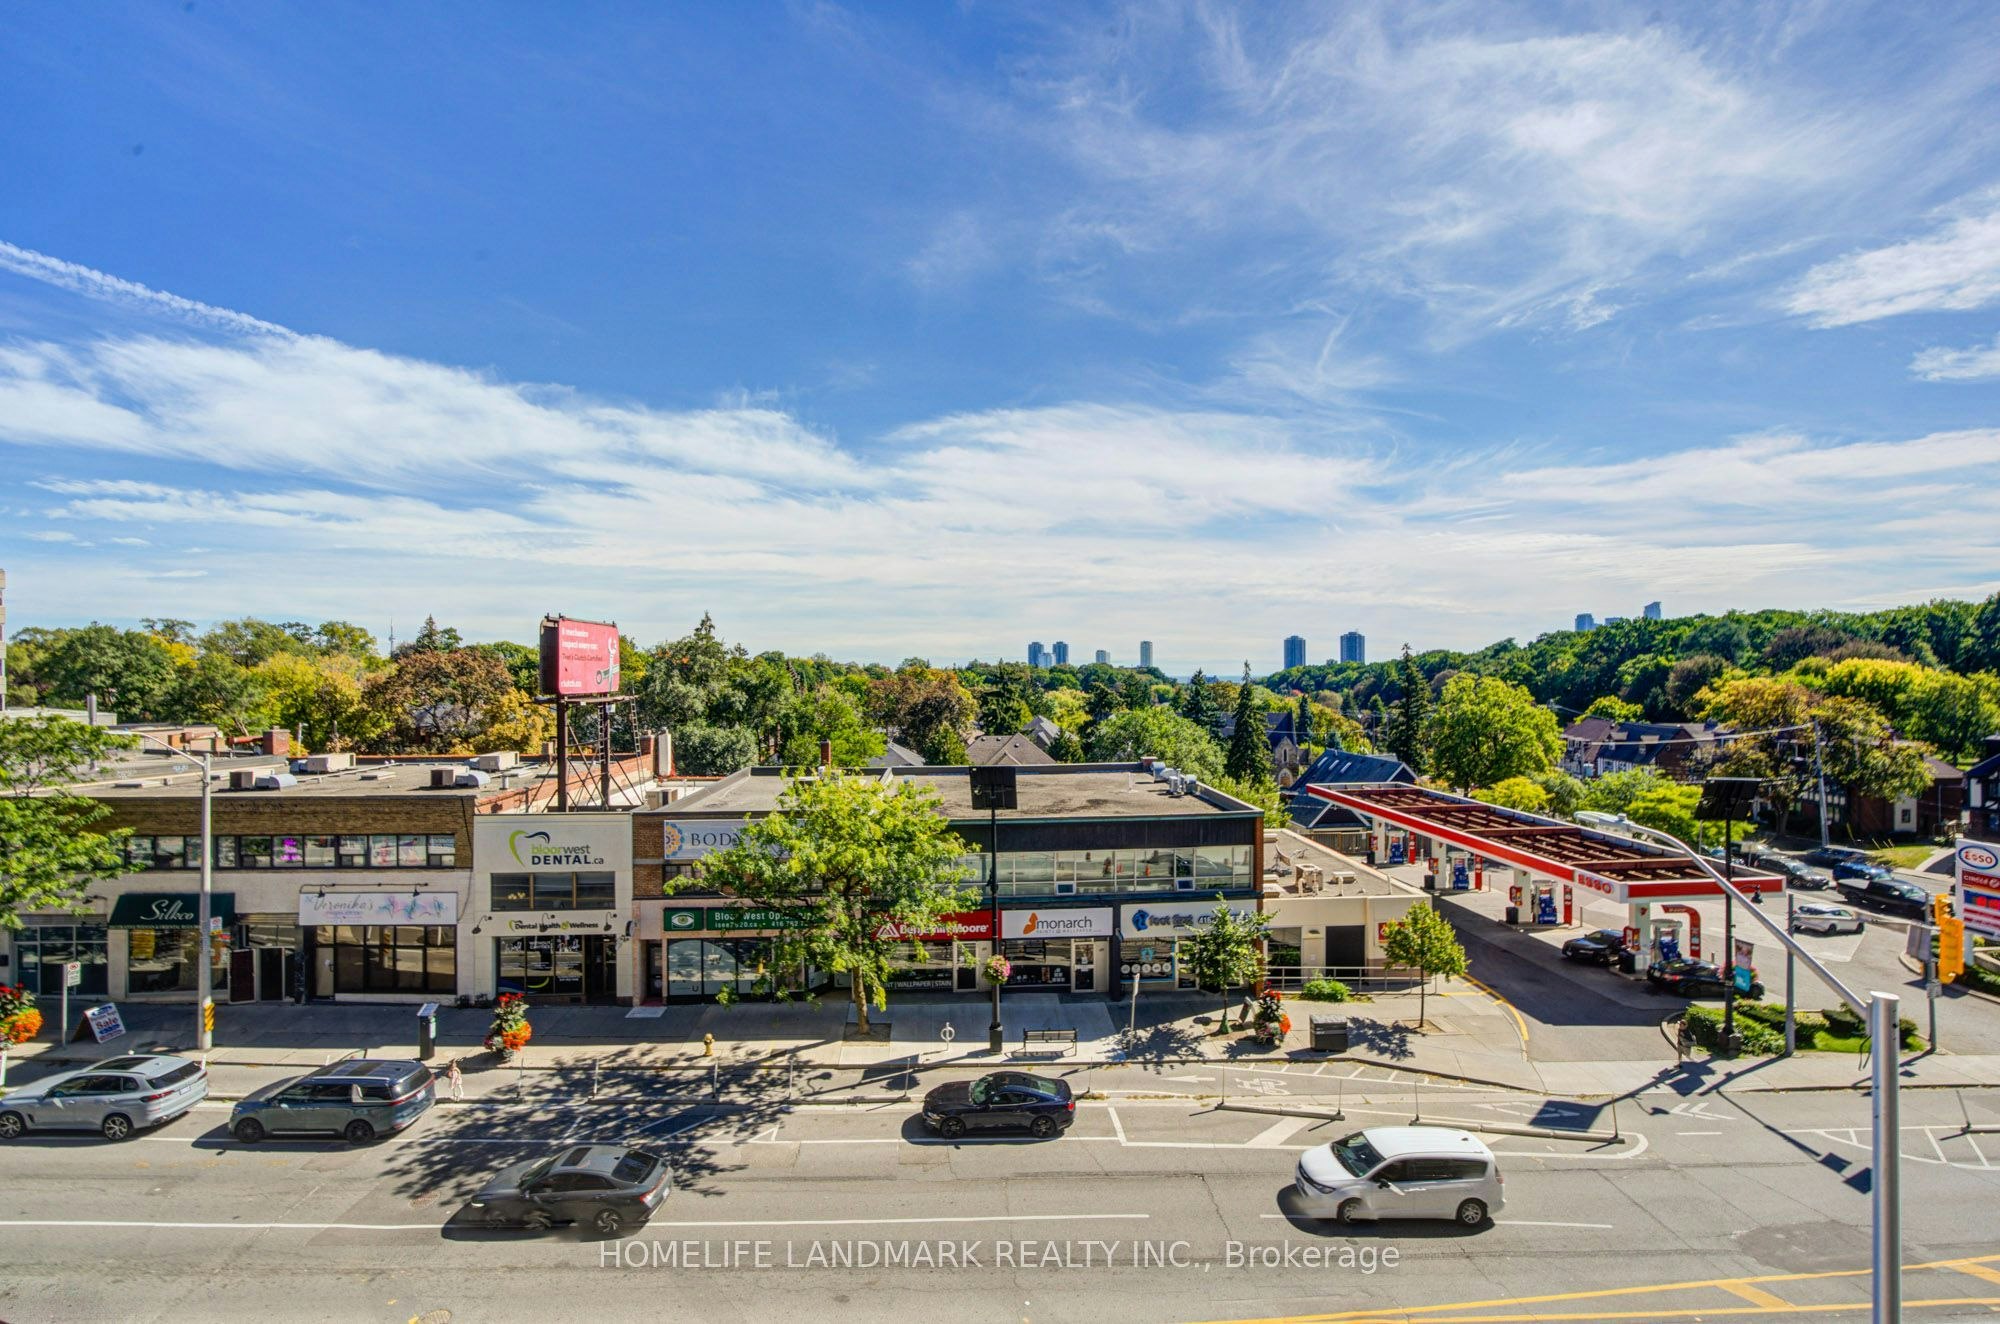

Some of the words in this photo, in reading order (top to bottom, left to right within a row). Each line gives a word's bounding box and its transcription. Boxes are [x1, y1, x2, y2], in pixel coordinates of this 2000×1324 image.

[531, 855, 605, 865] DENTAL.ca
[140, 900, 194, 920] Silkco
[743, 912, 765, 920] West
[515, 922, 538, 930] Dental
[1036, 916, 1093, 929] monarch
